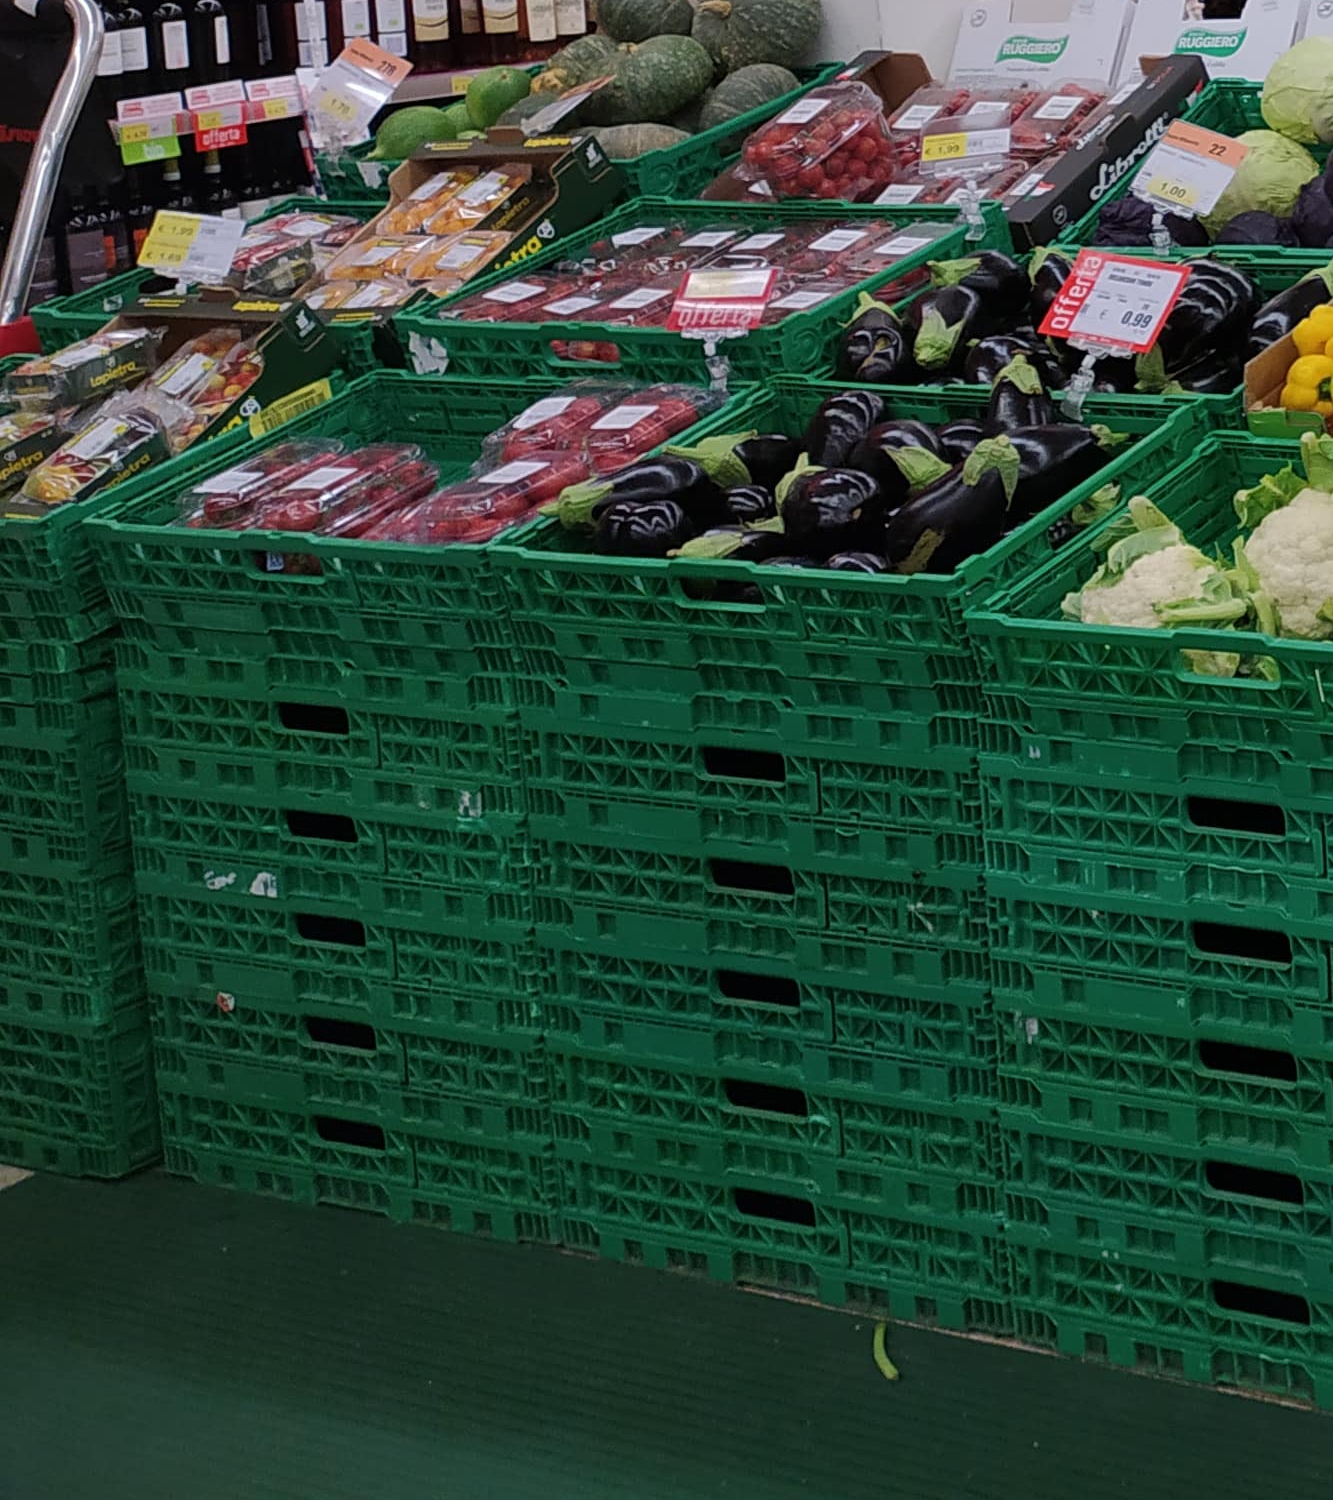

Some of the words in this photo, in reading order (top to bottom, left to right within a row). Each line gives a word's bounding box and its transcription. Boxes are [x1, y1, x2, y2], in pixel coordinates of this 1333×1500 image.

[1002, 38, 1062, 56] RUGGIERO
[1178, 33, 1239, 49] RUGGIERO
[202, 128, 242, 146] offerta
[1208, 142, 1226, 157] 22
[1051, 255, 1102, 330] offerta
